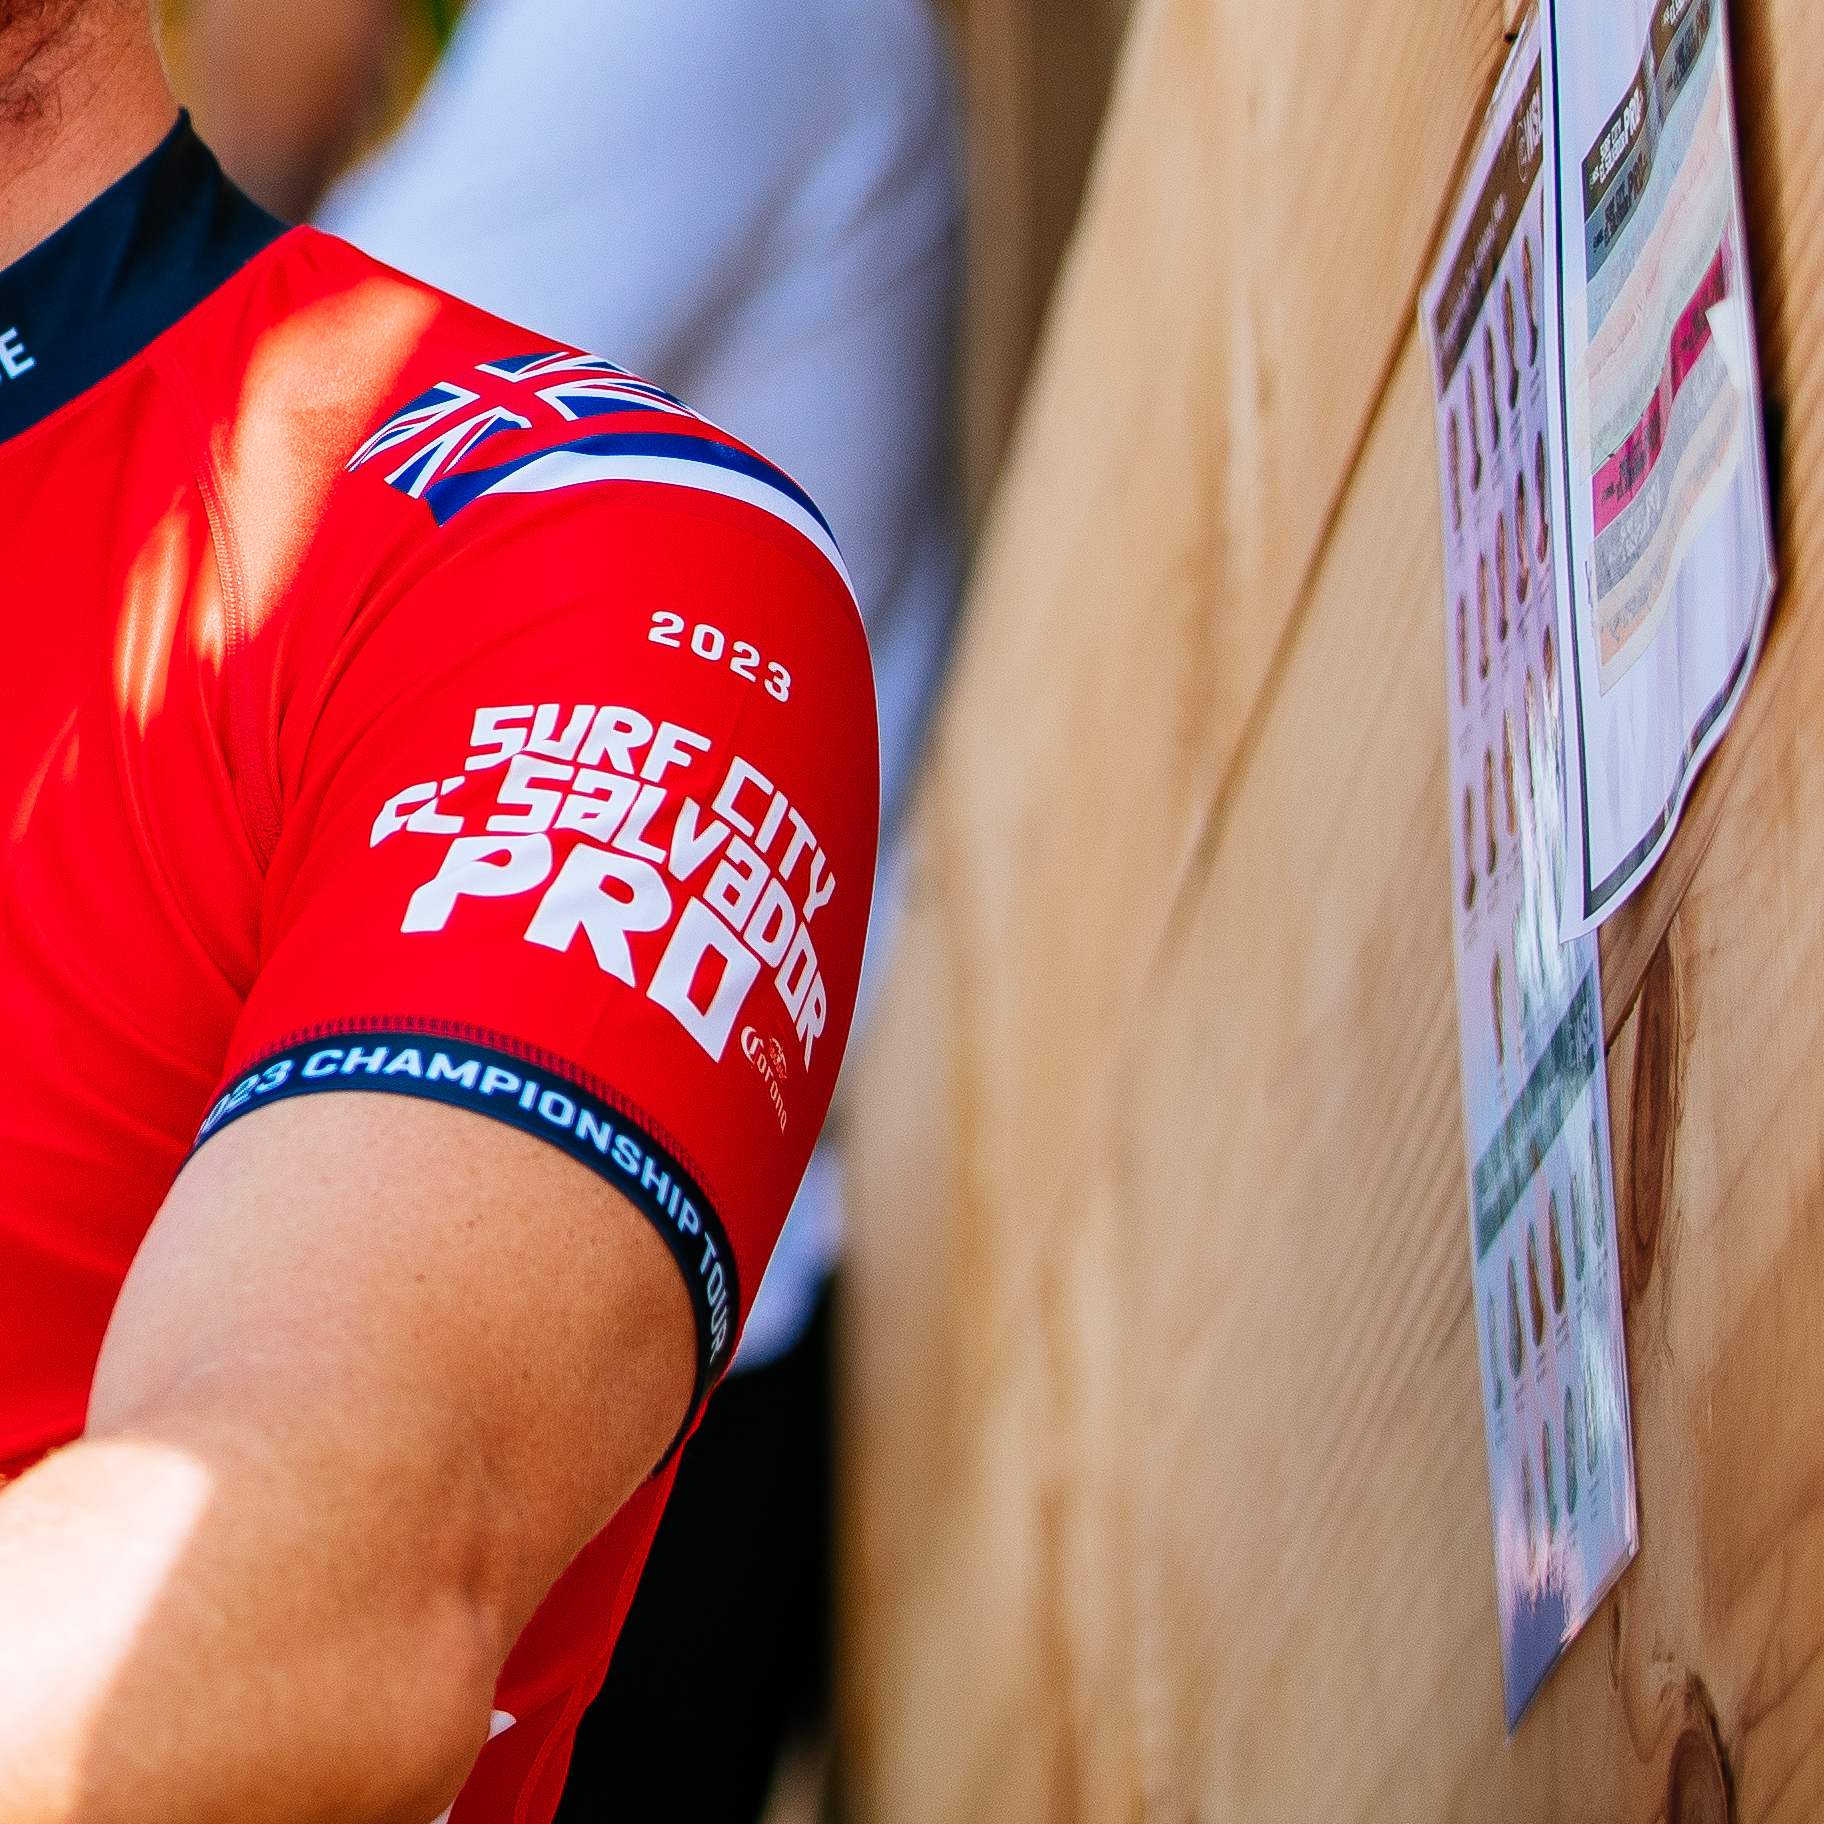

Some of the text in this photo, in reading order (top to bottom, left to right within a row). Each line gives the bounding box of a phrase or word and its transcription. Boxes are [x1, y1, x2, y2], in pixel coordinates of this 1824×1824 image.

[648, 610, 792, 703] 2023
[464, 704, 837, 923] SURF CITY
[400, 833, 762, 1063] PRO
[740, 1025, 788, 1135] Corona
[300, 1046, 701, 1236] CHAMPIONSHIP
[699, 1231, 728, 1365] TOUR
